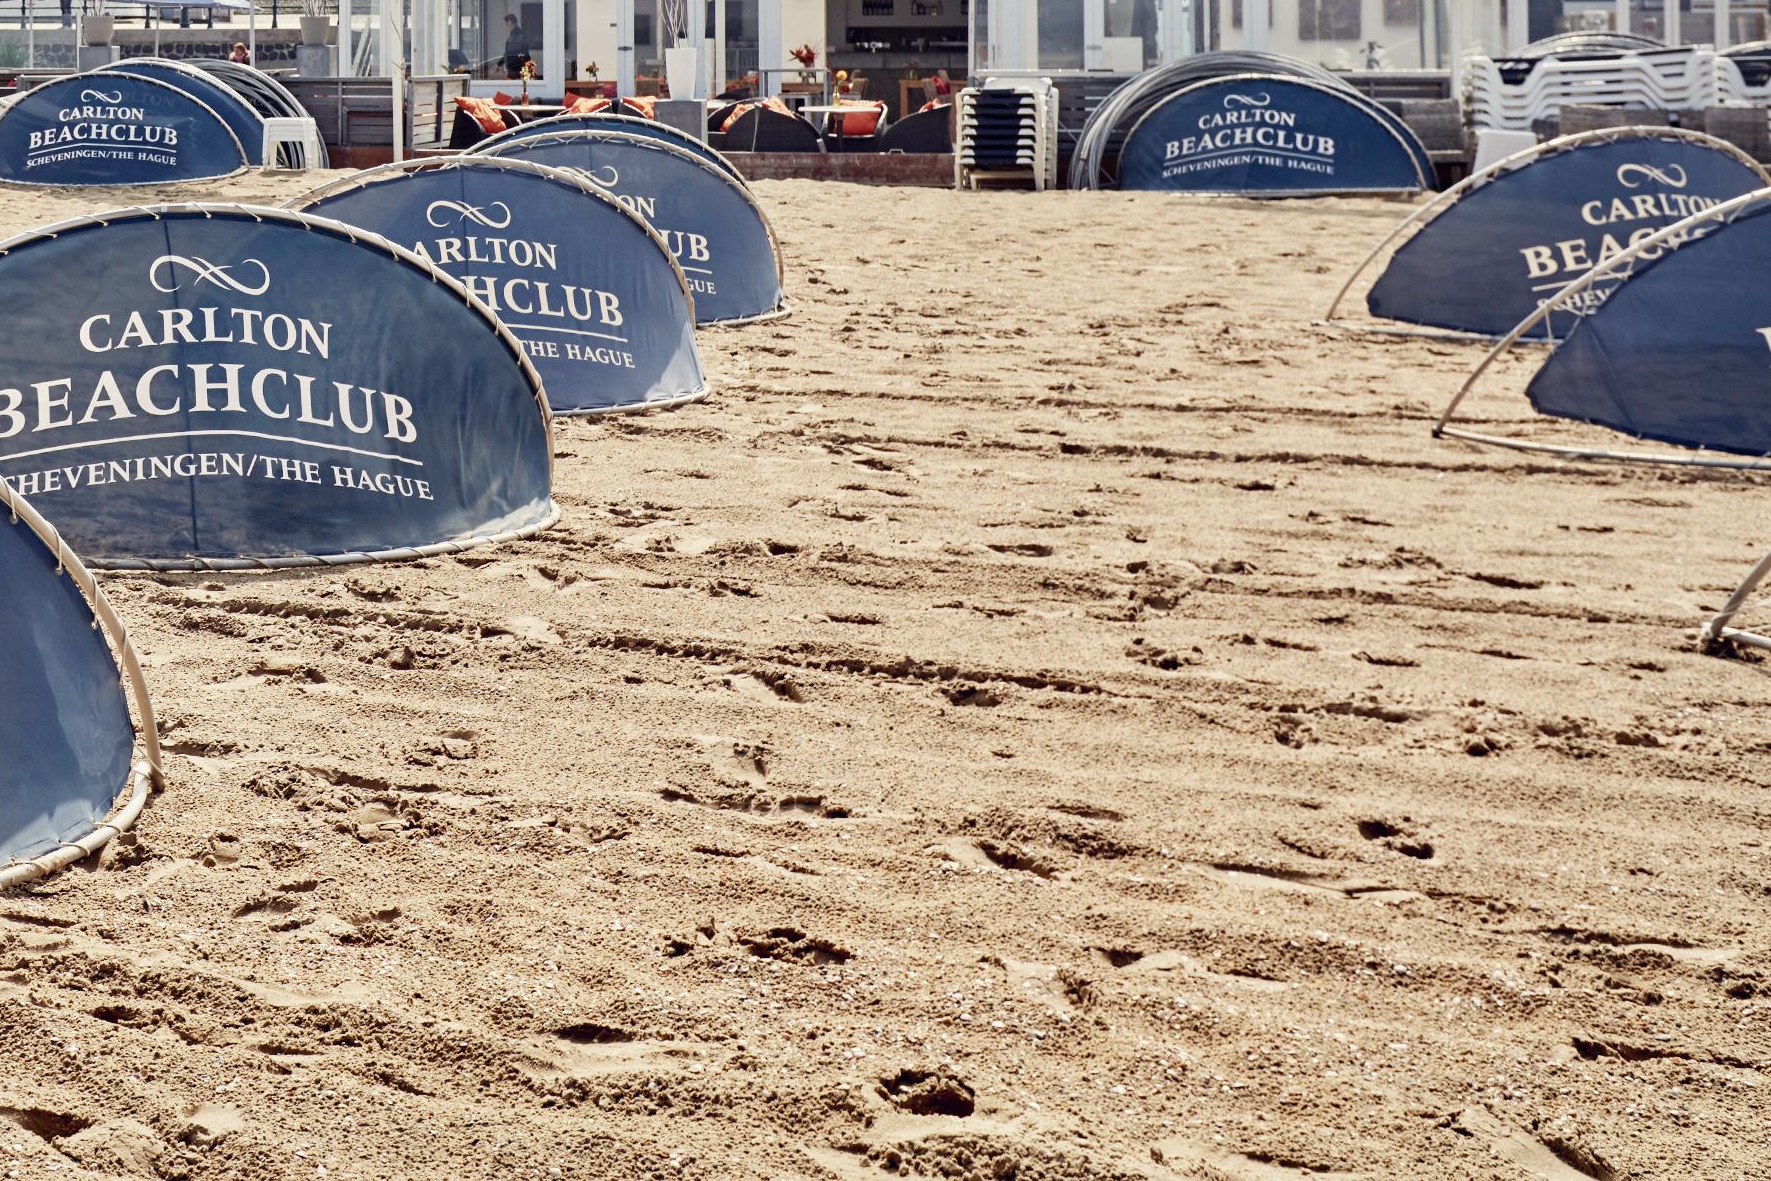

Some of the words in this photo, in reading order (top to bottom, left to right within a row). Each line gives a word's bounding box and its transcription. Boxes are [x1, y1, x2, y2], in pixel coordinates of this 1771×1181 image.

[59, 105, 145, 122] CARLTON
[1198, 109, 1296, 129] CARLTON
[28, 122, 178, 150] BEACHCLUB
[1165, 126, 1335, 159] BEACHCLUB
[26, 149, 134, 169] SCHEVENINGEN/THE
[138, 152, 177, 166] HAGUE
[1287, 158, 1335, 175] HAGUE
[79, 306, 332, 360] CARLTON
[565, 343, 635, 368] HAGUE
[333, 466, 434, 501] HAGUE
